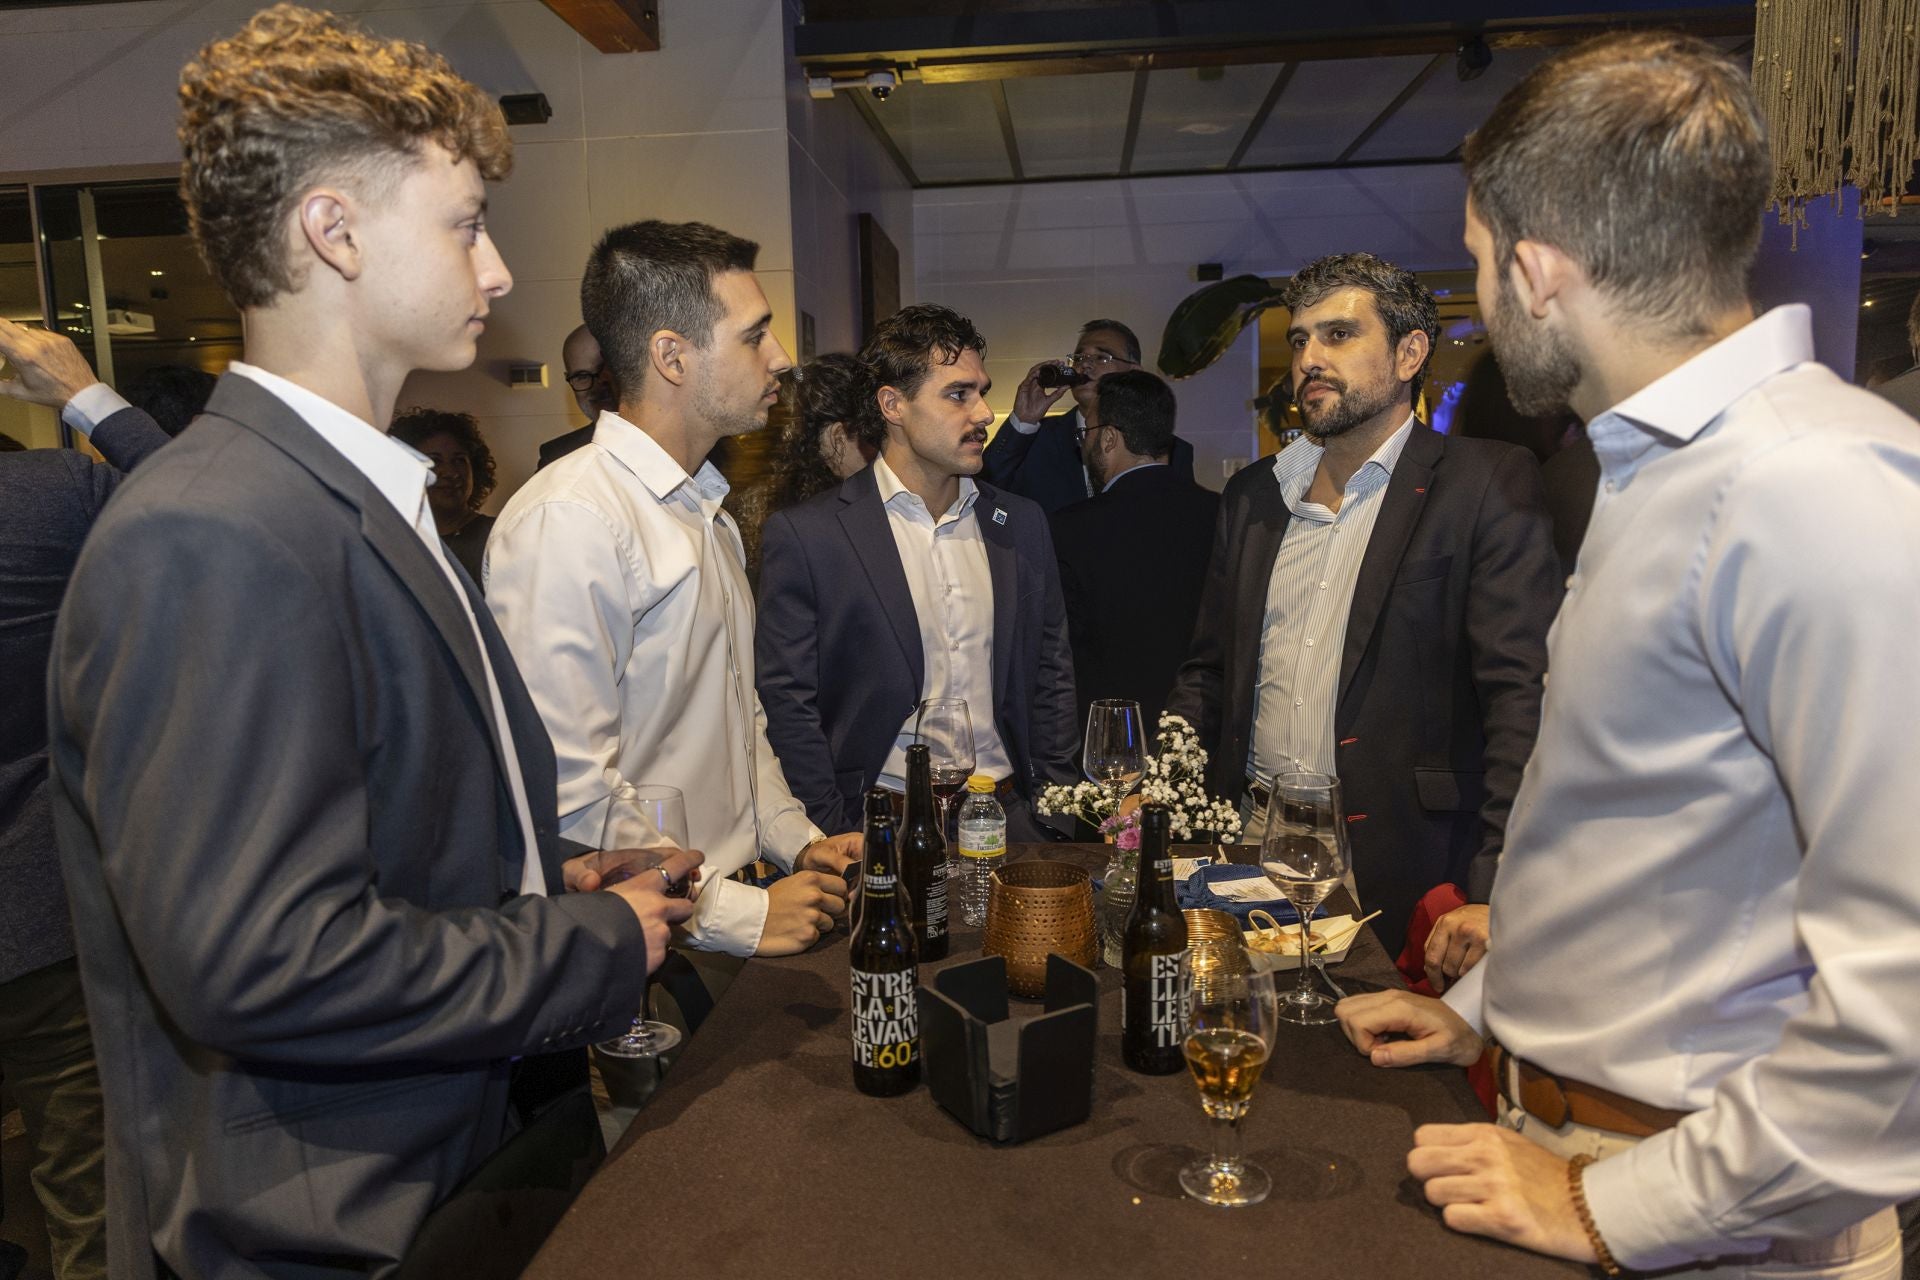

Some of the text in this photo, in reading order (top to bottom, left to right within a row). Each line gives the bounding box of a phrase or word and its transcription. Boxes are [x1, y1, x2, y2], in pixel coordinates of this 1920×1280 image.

[850, 966, 914, 998] ESTRE
[1151, 978, 1180, 1002] LL
[894, 991, 918, 1021] DE
[851, 1013, 918, 1045] LEVAN
[853, 1037, 873, 1068] TE
[878, 1041, 911, 1069] 60
